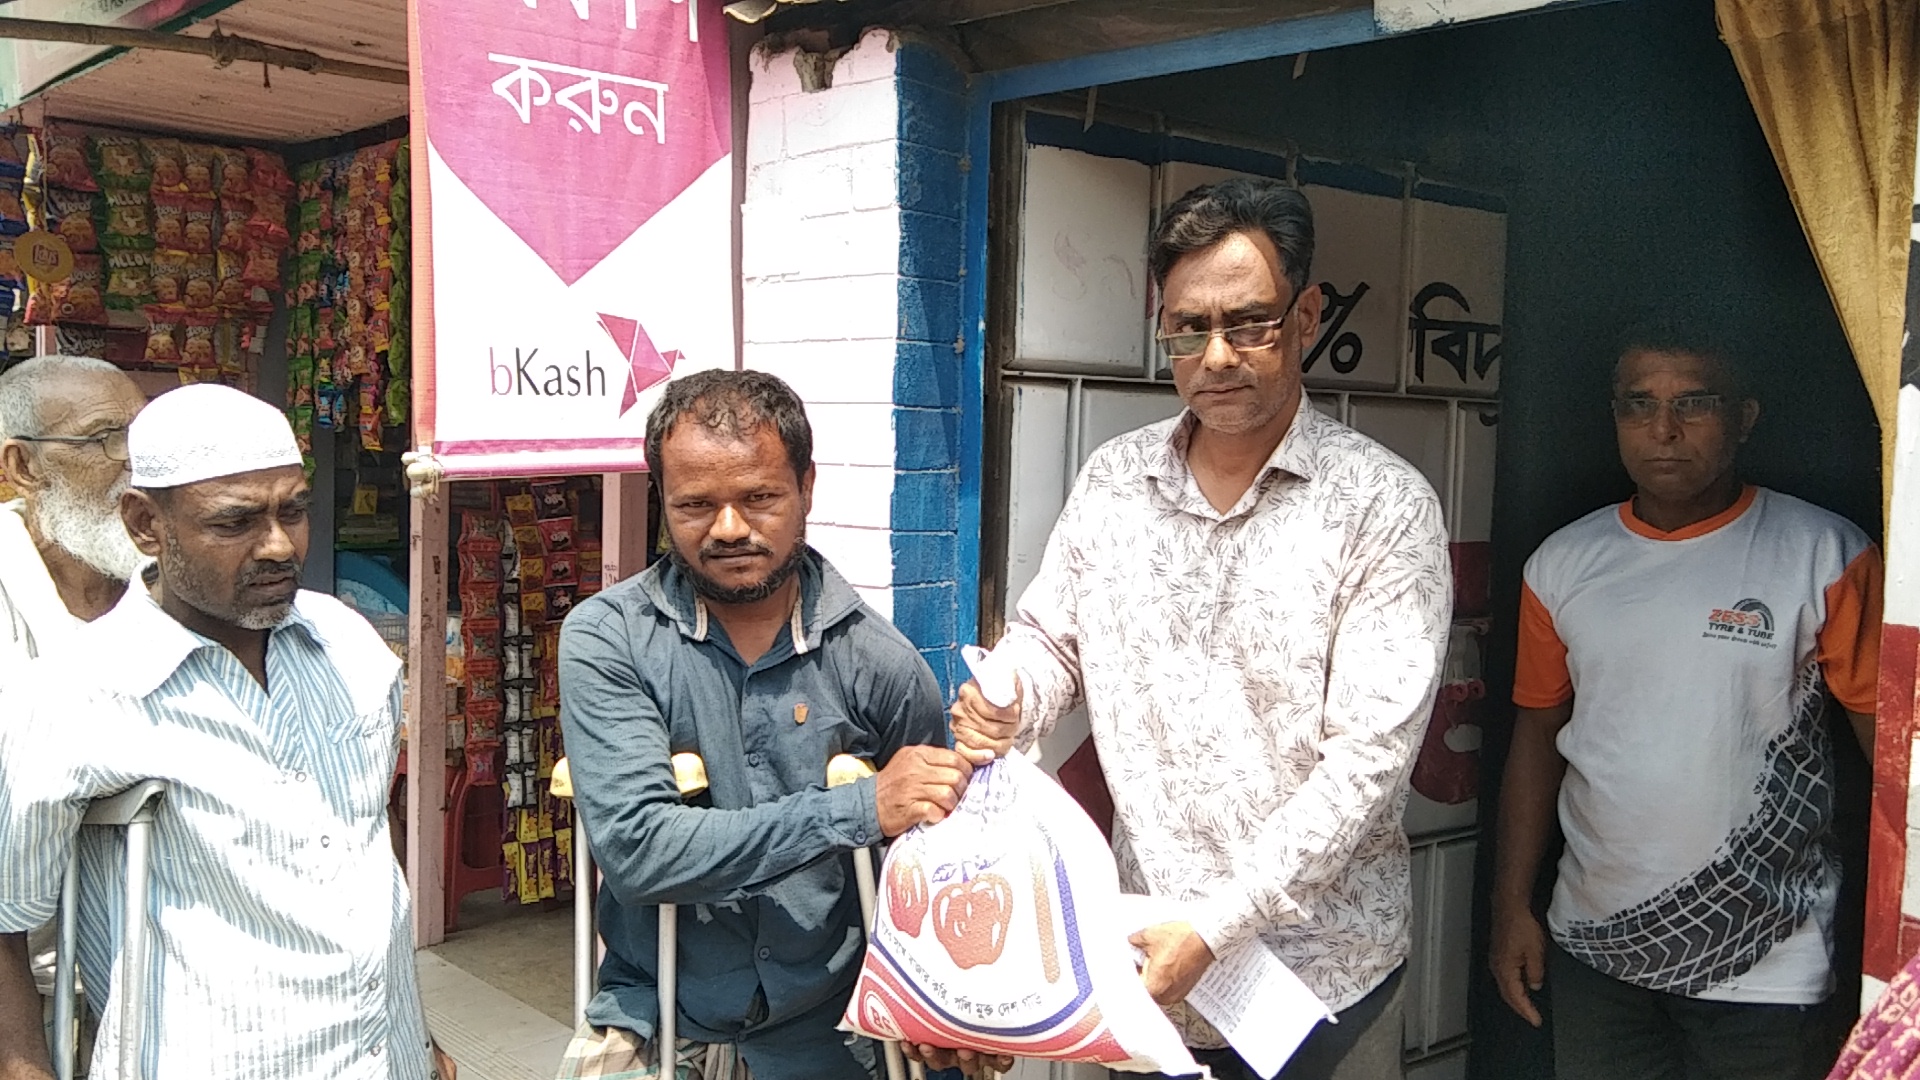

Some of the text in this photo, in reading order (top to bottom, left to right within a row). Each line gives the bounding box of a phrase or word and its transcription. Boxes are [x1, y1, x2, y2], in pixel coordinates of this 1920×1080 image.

[488, 52, 669, 144] করুন
[489, 346, 606, 397] bKash
[1708, 622, 1735, 633] TYRE
[1747, 628, 1774, 640] TUBE
